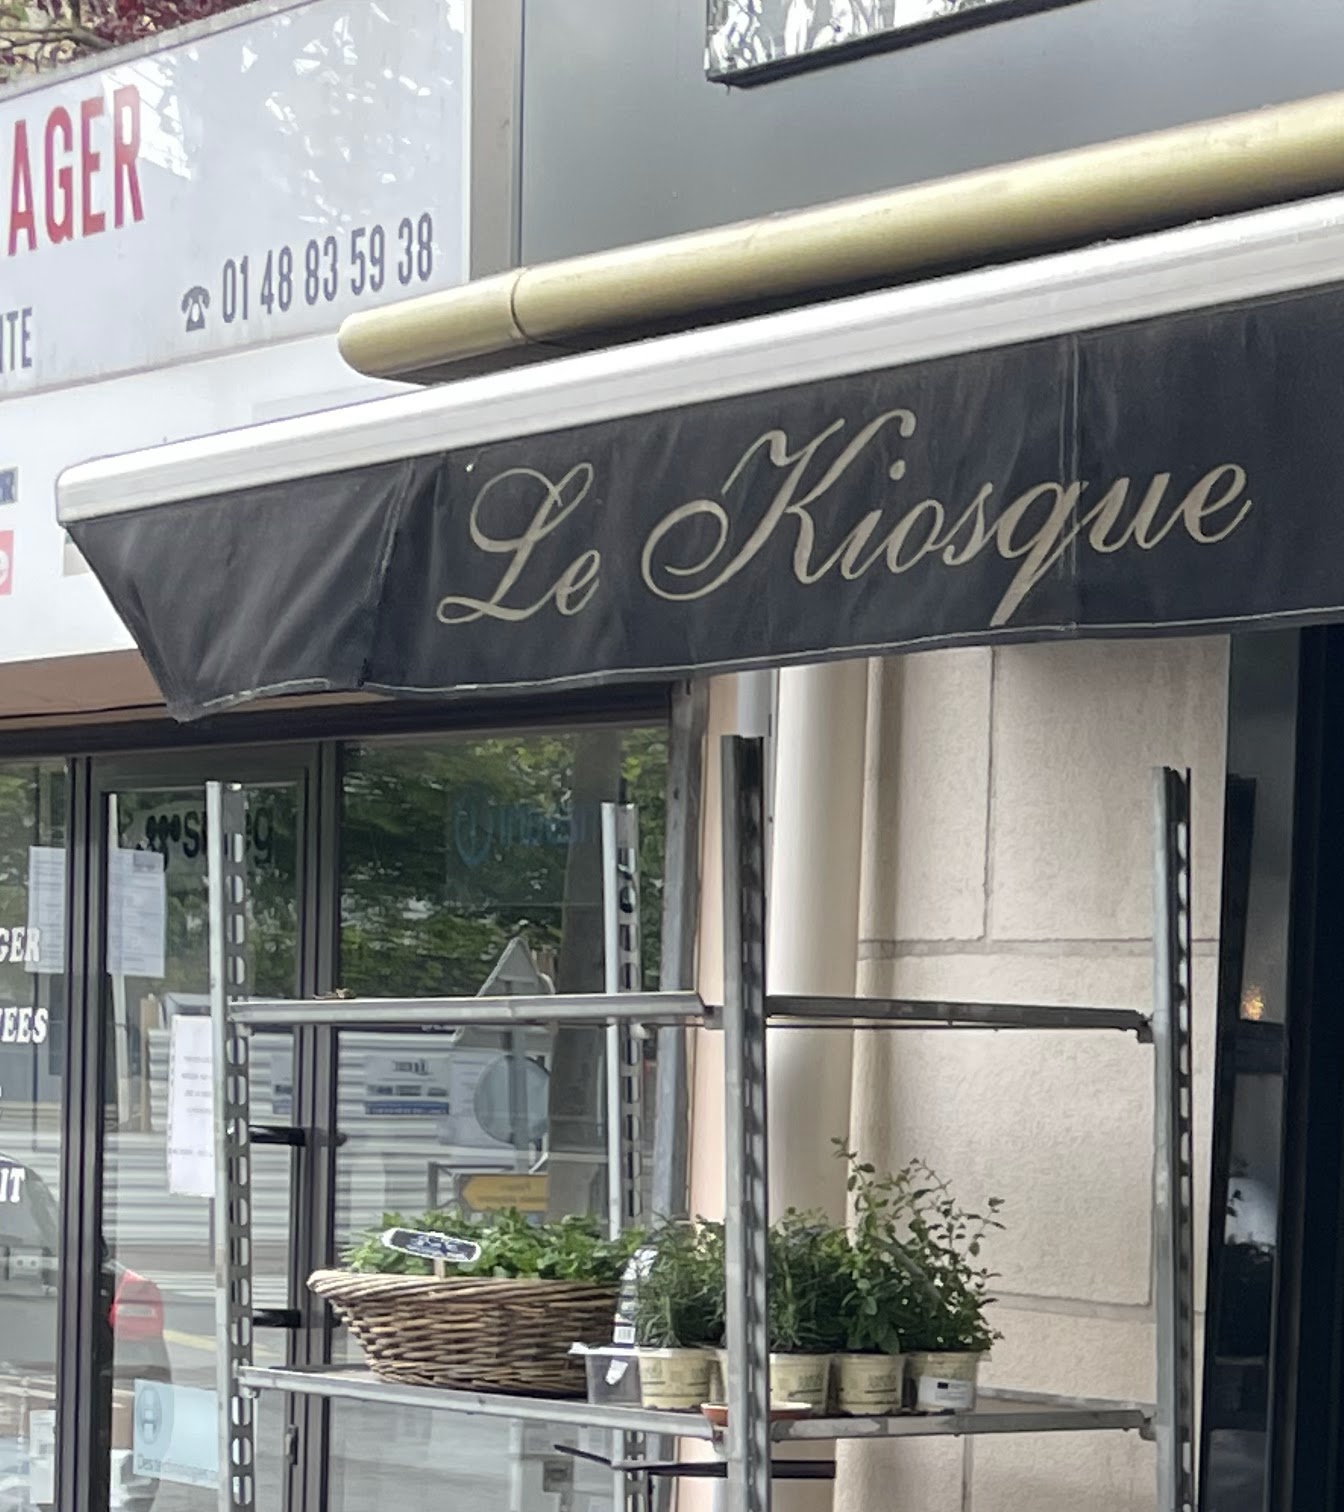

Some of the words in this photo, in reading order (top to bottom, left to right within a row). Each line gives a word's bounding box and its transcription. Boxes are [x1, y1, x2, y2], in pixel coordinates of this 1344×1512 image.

[7, 85, 144, 257] AGER
[222, 259, 250, 324] 01
[260, 247, 293, 315] 48
[304, 236, 339, 304] 83
[349, 224, 388, 296] 59
[398, 213, 433, 284] 38
[436, 462, 600, 625] Le
[642, 410, 1252, 627] Kiosque
[0, 1007, 49, 1044] EES
